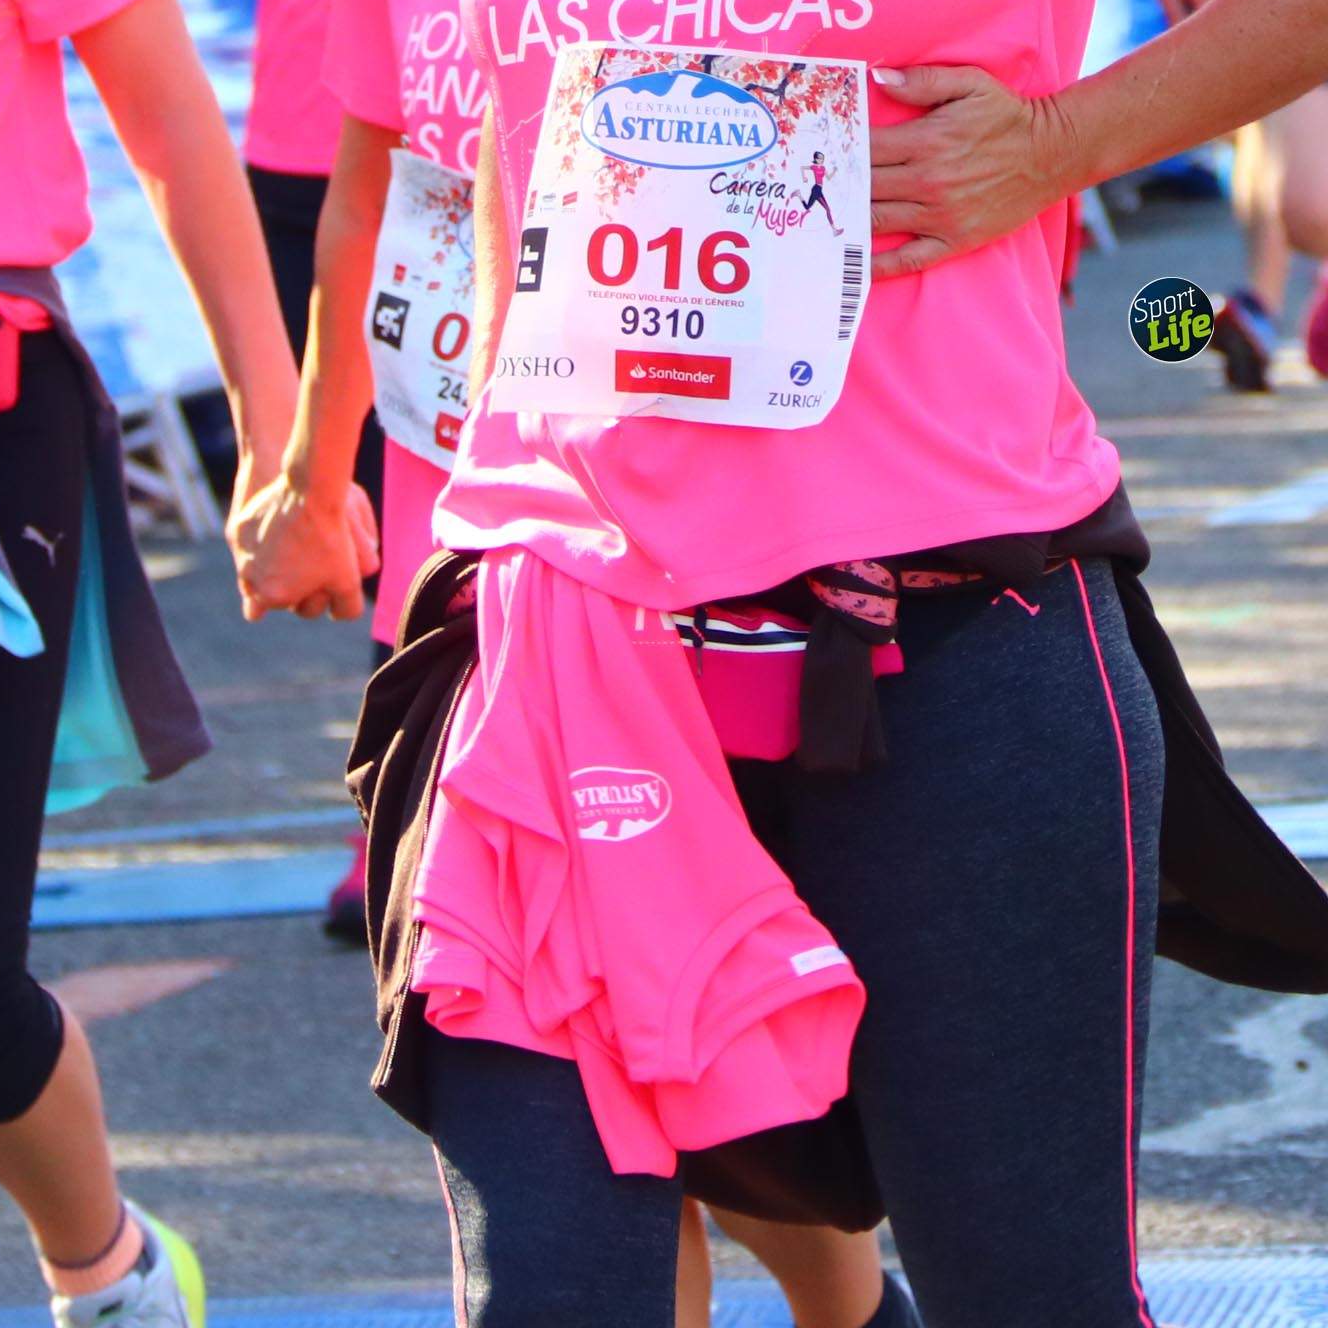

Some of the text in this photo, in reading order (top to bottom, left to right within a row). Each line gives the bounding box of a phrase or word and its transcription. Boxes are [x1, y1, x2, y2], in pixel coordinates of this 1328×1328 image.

[624, 101, 759, 118] CENTRAL LECHERA
[592, 101, 763, 148] ASTURIANA
[709, 171, 786, 199] Carrera
[726, 198, 811, 236] de la Mujer
[586, 223, 751, 294] 016
[638, 293, 688, 305] VIOLENCIA
[691, 297, 703, 305] DE
[621, 305, 705, 339] 9310
[648, 366, 715, 384] Santander
[768, 391, 822, 408] ZURICH
[573, 779, 660, 808] ASTURIA
